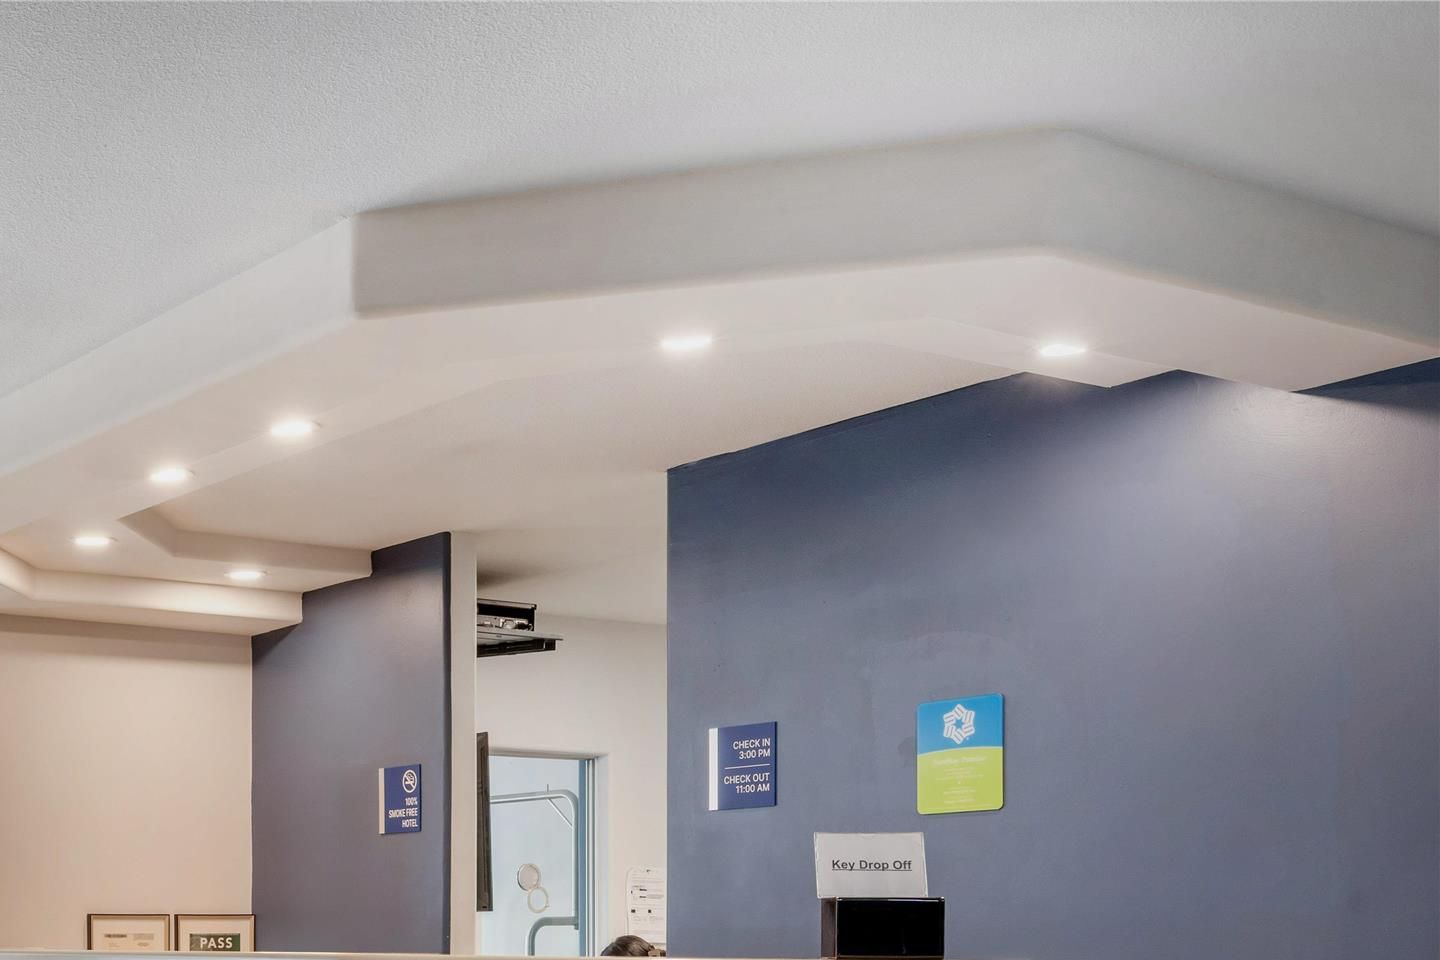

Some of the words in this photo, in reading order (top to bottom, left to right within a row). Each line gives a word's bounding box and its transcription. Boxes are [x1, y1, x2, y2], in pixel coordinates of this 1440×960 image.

[733, 739, 760, 750] CHECK
[762, 738, 770, 747] IN
[739, 750, 756, 760] 3:00
[758, 748, 770, 757] PM
[724, 774, 750, 785] CHECK
[752, 772, 770, 782] OUT
[736, 785, 755, 794] 11:00
[757, 783, 770, 792] AM
[405, 797, 418, 806] 100%
[389, 808, 405, 818] SMOKE
[406, 807, 418, 817] FREE
[402, 818, 418, 828] HOTEL
[832, 859, 855, 871] Key
[859, 860, 889, 871] Drop
[892, 860, 912, 870] Off
[199, 937, 233, 949] PASS
